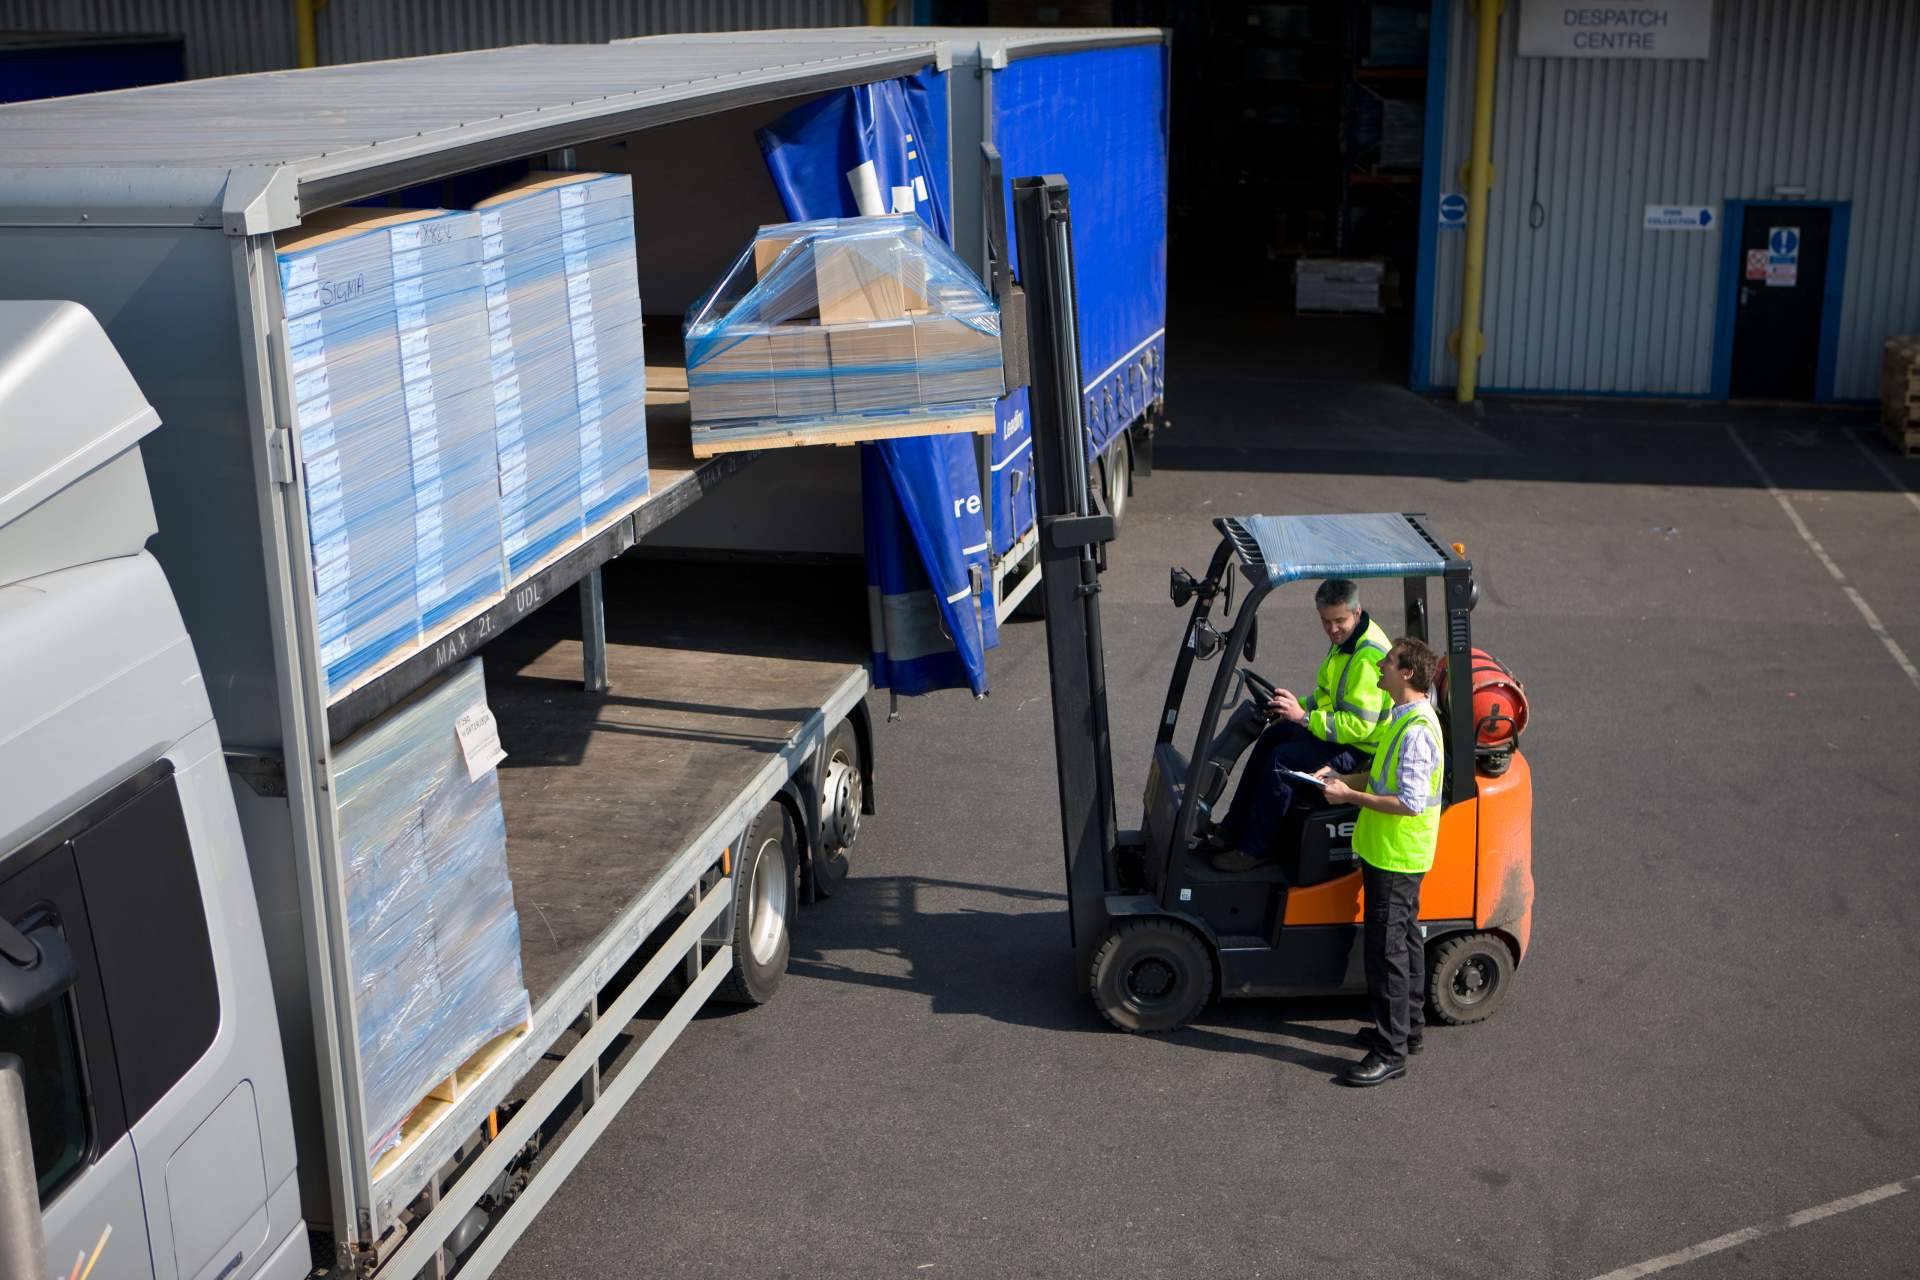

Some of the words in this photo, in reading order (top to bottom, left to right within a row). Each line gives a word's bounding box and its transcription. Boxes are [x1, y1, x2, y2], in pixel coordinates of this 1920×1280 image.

[1564, 9, 1668, 27] DESPATCH
[1573, 32, 1656, 49] CENTRE
[320, 272, 365, 305] SIGMA
[953, 494, 981, 518] re
[436, 631, 467, 667] MAX
[516, 583, 541, 613] UDL
